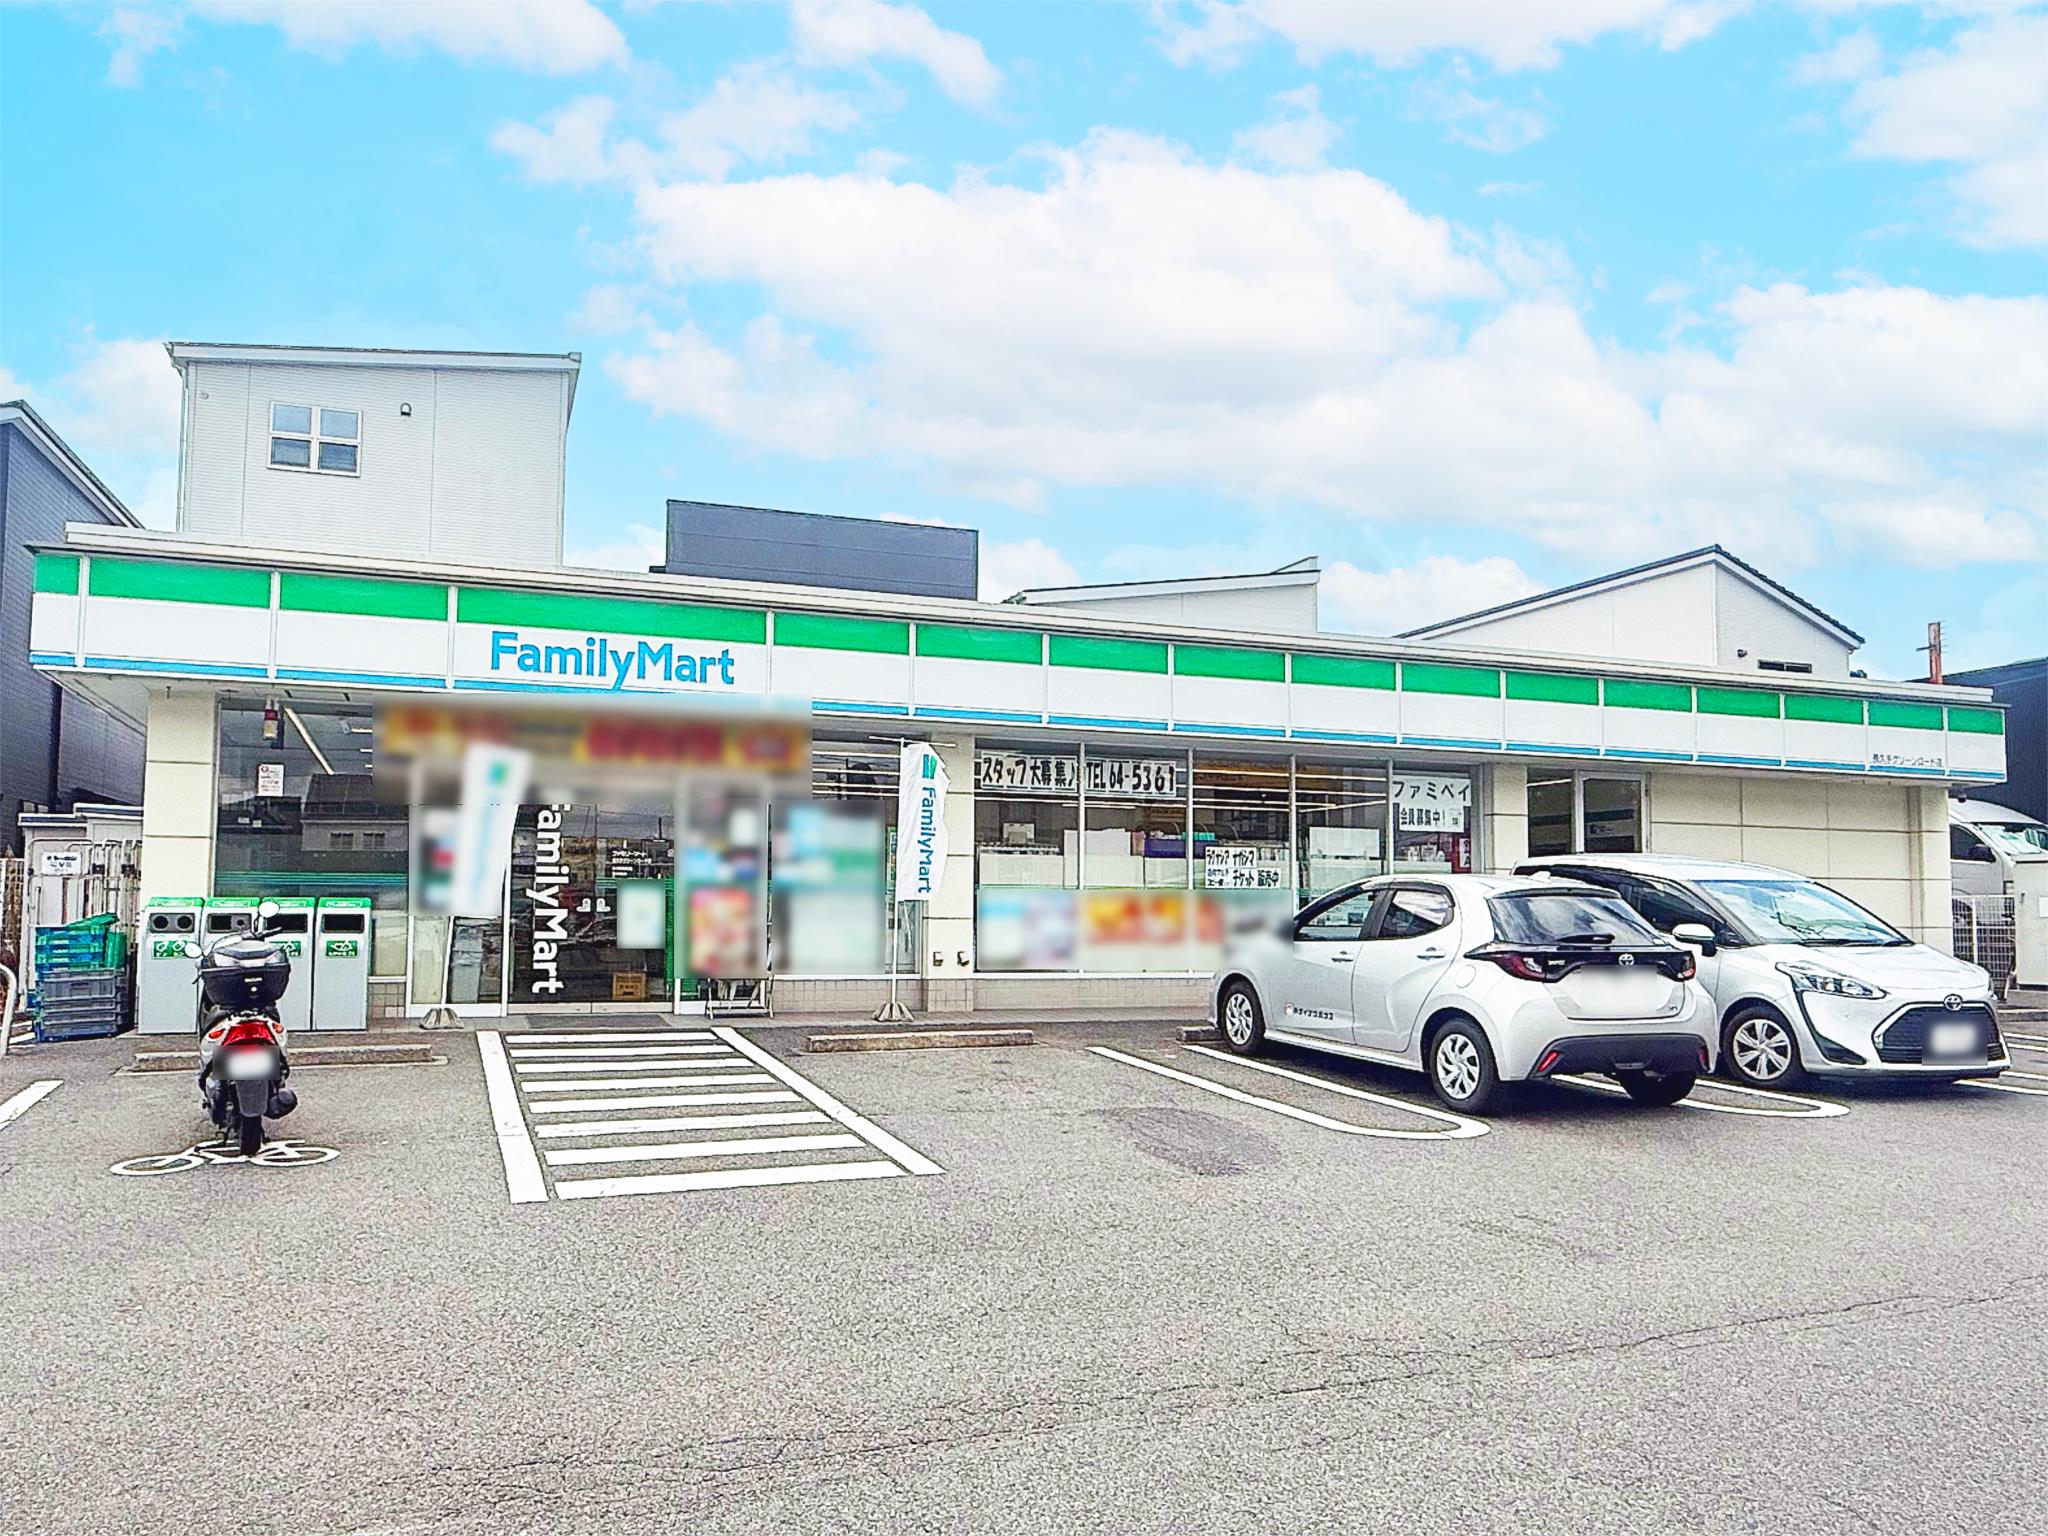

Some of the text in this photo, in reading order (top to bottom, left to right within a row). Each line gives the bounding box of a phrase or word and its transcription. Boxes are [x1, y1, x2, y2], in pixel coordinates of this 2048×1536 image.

[491, 630, 735, 690] FamilyMart
[1086, 762, 1105, 789] TEL
[1109, 763, 1175, 792] 64-5361
[1392, 781, 1470, 802] ファミペイ
[917, 786, 937, 894] FamilyMart
